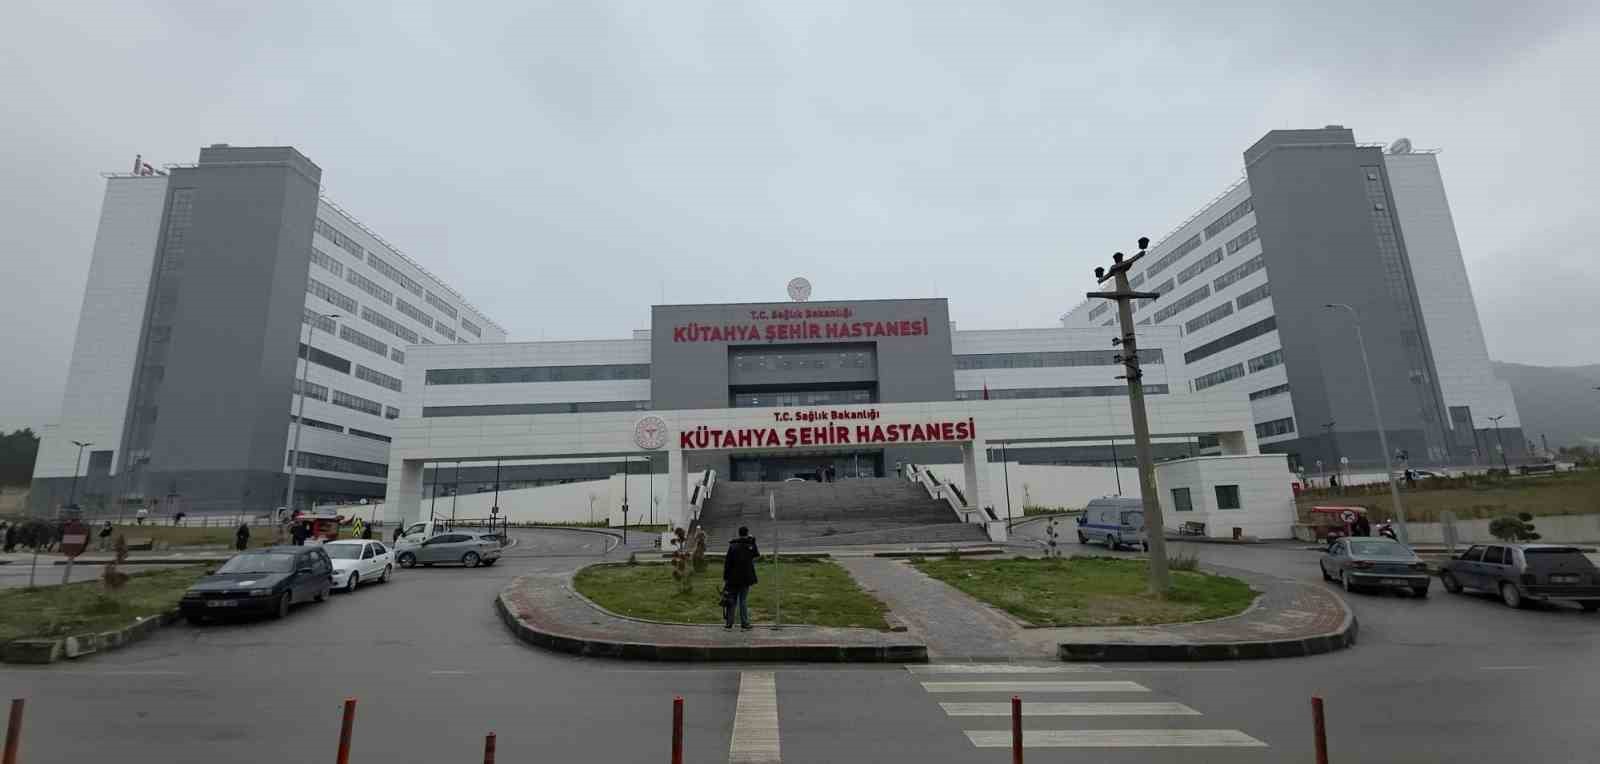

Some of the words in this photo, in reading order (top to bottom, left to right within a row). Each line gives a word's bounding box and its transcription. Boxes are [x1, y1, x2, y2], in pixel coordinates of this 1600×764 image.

[750, 310, 769, 320] T.C.
[673, 322, 760, 342] KÜTAHYA
[766, 320, 821, 343] ŞEHİR
[825, 317, 928, 338] HASTANESİ
[774, 412, 793, 421] T.C.
[795, 410, 828, 422] Sağlık
[831, 408, 880, 420] Bakanlığı
[680, 425, 780, 448] KÜTAHYA
[784, 421, 850, 448] ŞEHİR
[856, 417, 976, 442] HASTANESİ
